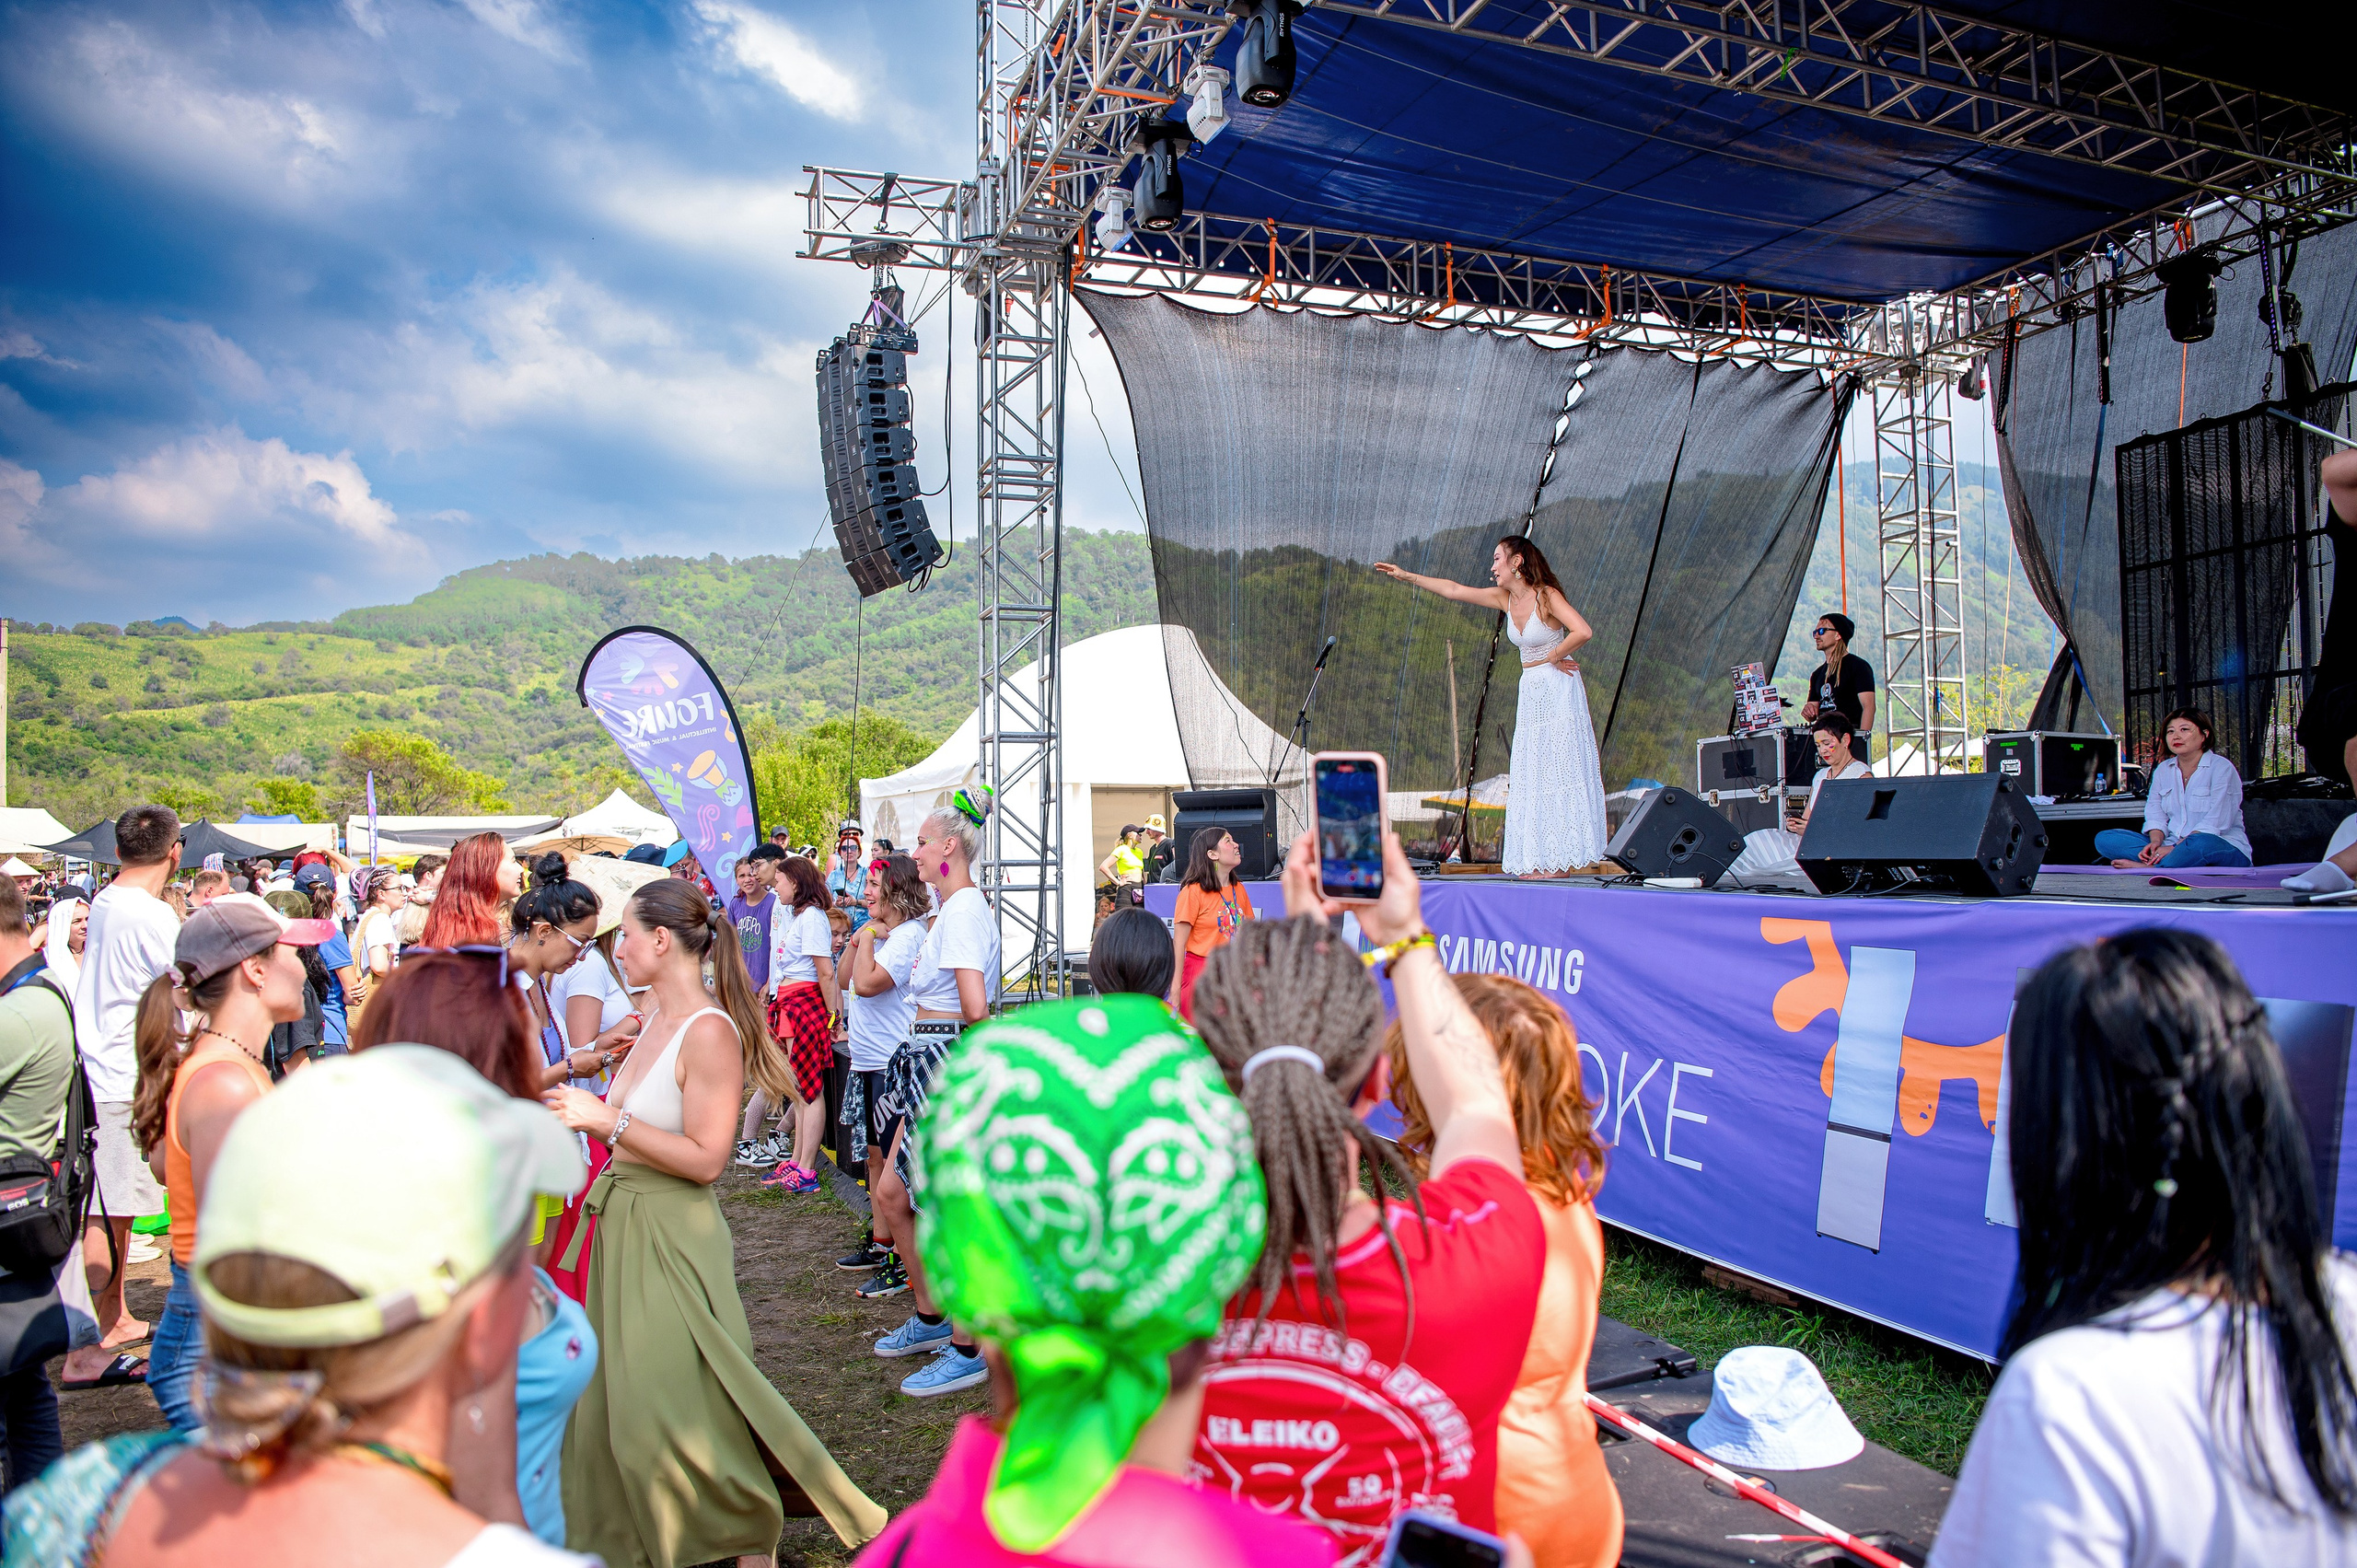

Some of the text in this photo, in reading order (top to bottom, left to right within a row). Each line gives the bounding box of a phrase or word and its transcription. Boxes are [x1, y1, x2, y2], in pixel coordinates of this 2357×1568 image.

[1438, 933, 1585, 995] SAMSUNG
[873, 1089, 901, 1140] UM
[1577, 1042, 1713, 1171] OKE
[6, 1197, 30, 1212] EOS
[1207, 1414, 1341, 1452] ELEIKO
